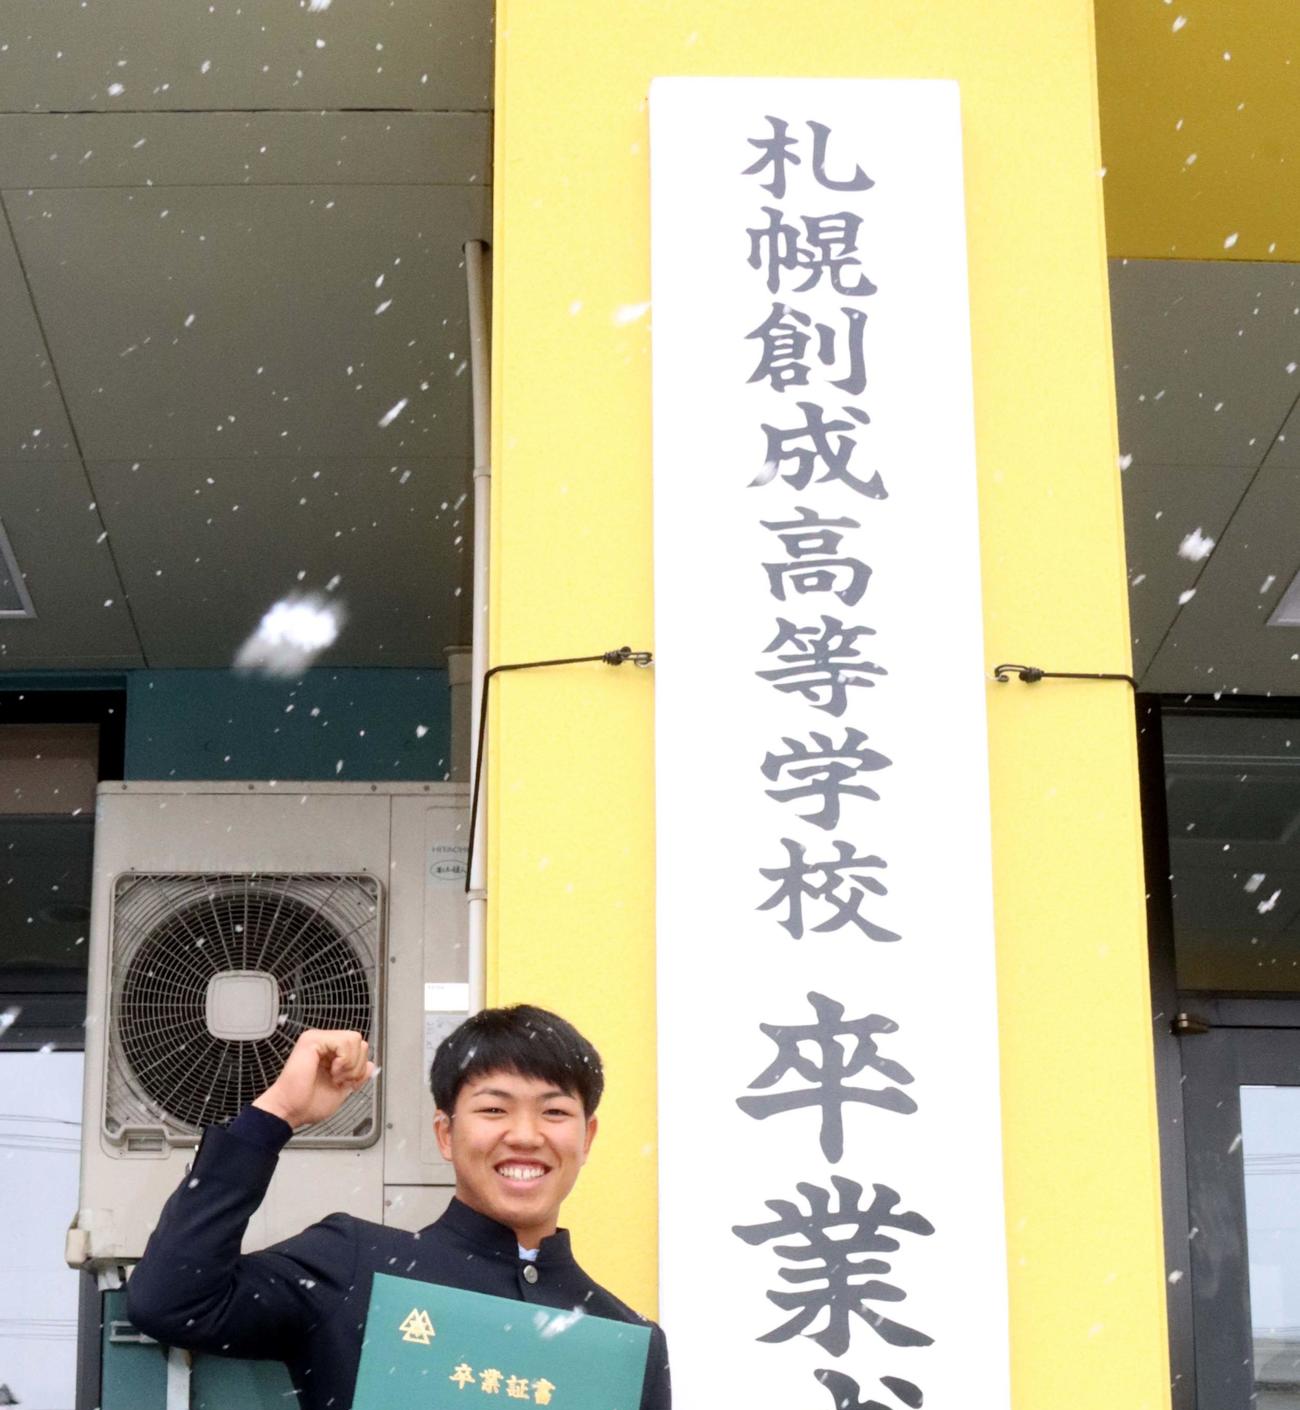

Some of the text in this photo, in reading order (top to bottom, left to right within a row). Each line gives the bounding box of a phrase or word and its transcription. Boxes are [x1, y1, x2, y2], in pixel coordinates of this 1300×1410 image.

[743, 116, 902, 942] 札幌創成高等学校
[431, 845, 467, 854] HITACH
[448, 1362, 556, 1406] 卒業証書
